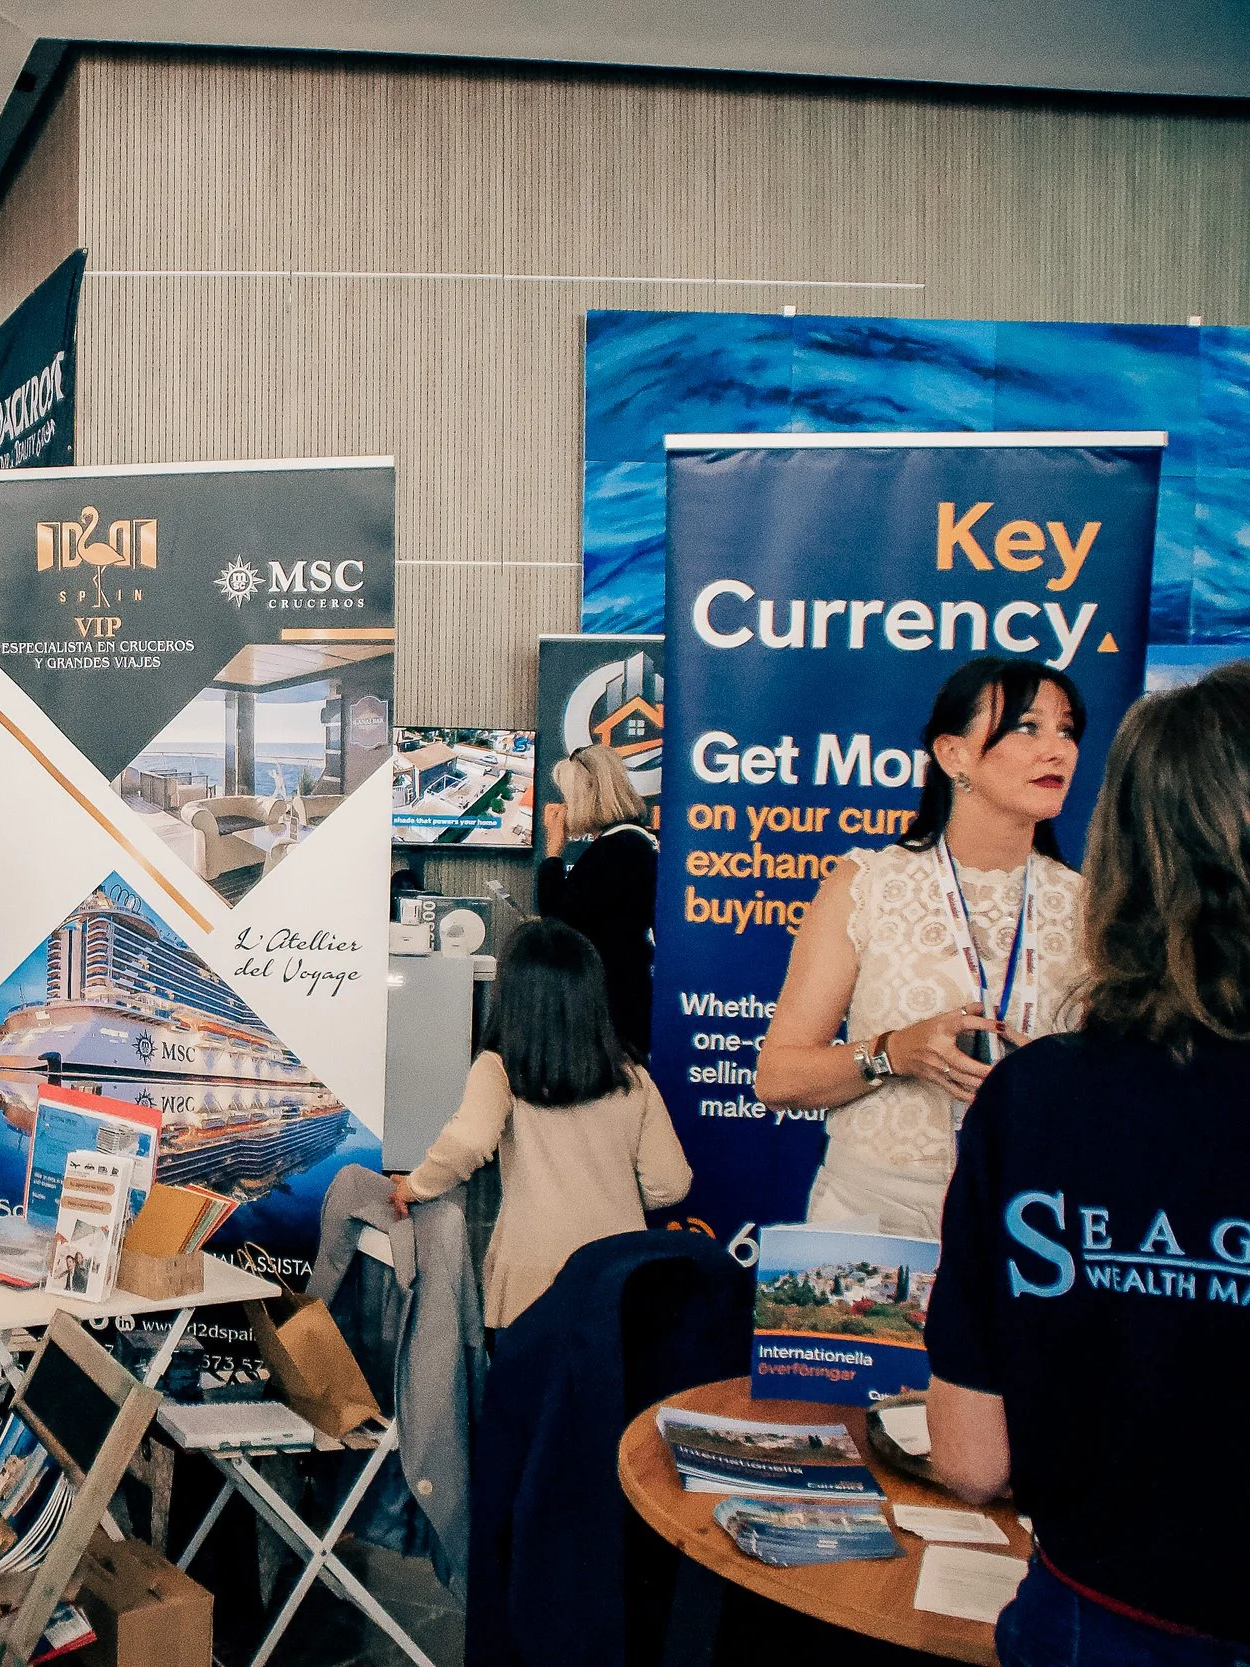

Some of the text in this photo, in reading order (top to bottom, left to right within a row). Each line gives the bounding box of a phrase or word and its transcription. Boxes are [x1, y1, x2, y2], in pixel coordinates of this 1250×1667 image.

[937, 501, 1102, 592] Key
[268, 560, 364, 592] MSC
[268, 599, 364, 609] CRUCEROS
[74, 617, 122, 637] VIP
[693, 579, 1098, 670] Currency
[2, 640, 195, 654] ESPECIALISTA EN CRUCEROS
[35, 656, 161, 668] Y GRANDES VIAJES
[693, 730, 932, 788] Get Mor
[432, 818, 458, 826] powers
[688, 803, 916, 840] on your curr
[686, 842, 844, 879] exchan
[686, 885, 811, 937] buying
[234, 957, 362, 997] del Voyage
[680, 993, 776, 1018] Whethe
[161, 1041, 196, 1062] MSC
[694, 1032, 765, 1051] one-o
[690, 1061, 757, 1085] sellin
[701, 1095, 766, 1118] make
[1085, 1265, 1196, 1299] WEALTH
[759, 1345, 873, 1367] Internationella
